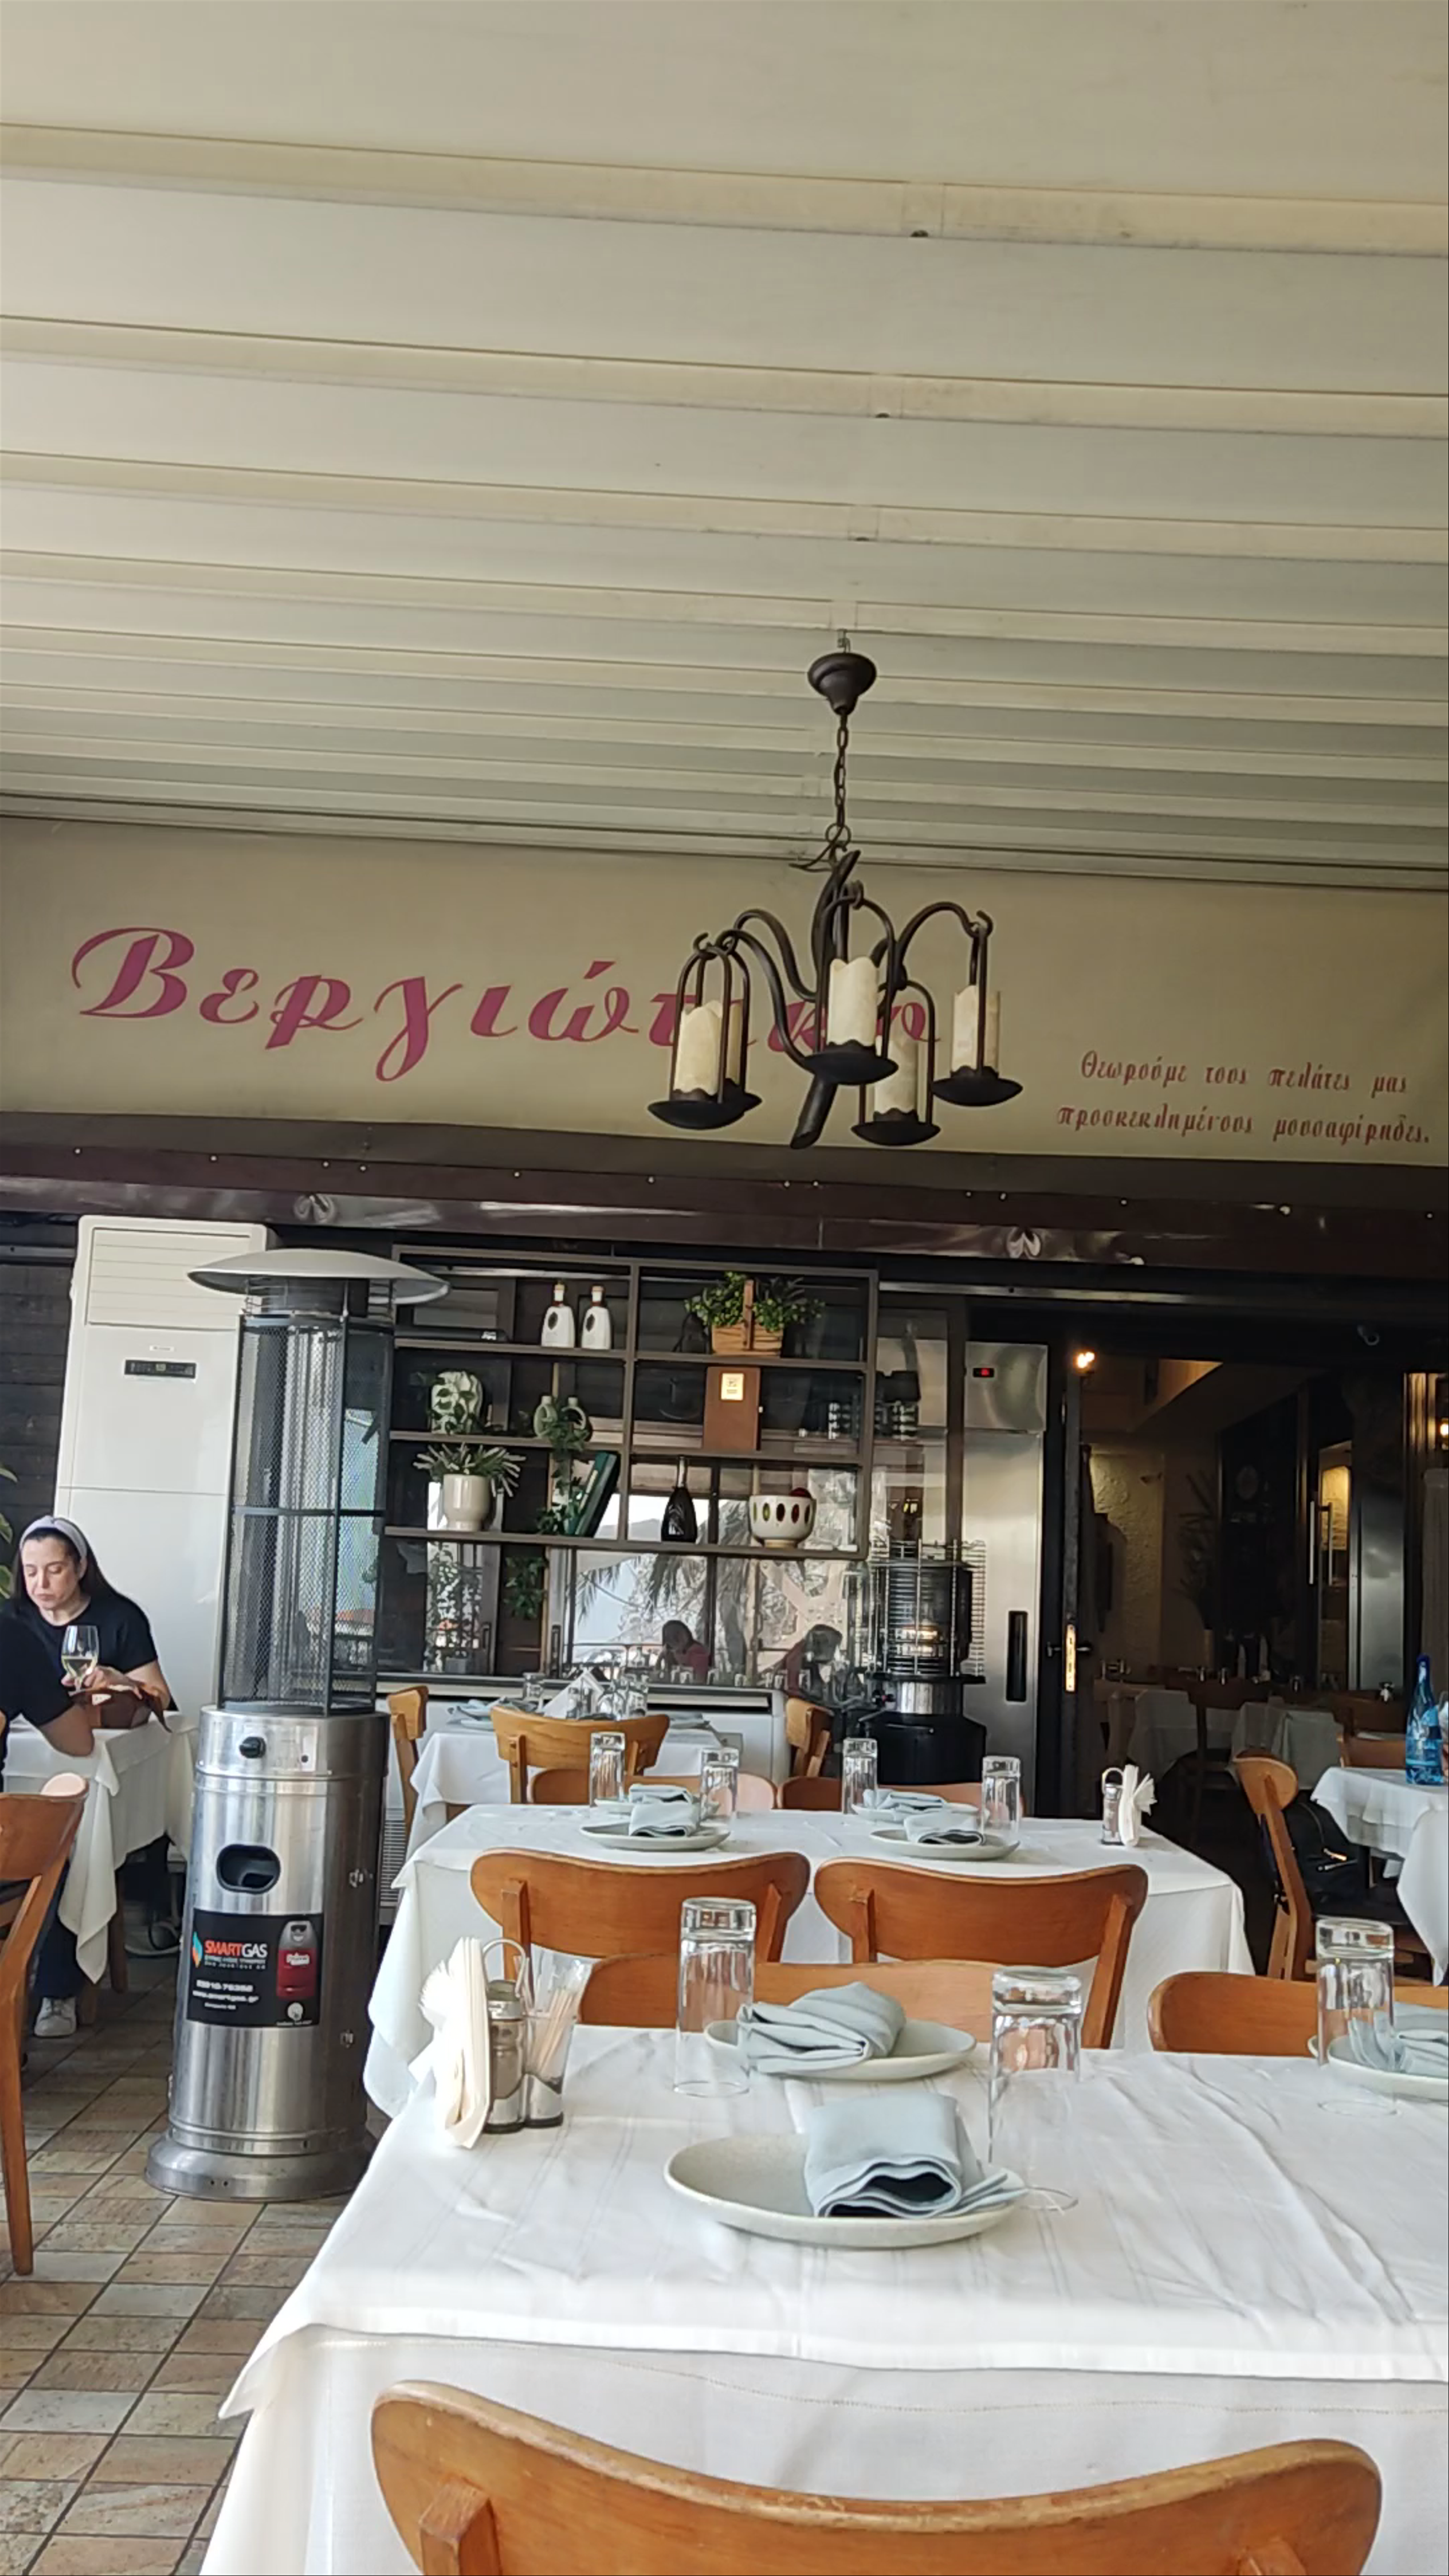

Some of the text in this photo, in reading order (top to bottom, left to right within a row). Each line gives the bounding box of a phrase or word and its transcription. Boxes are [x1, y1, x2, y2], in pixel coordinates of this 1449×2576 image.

[72, 926, 941, 1082] Βεργιώτκο
[1081, 1050, 1407, 1100] Θεωρούμε τους πελάτες μας
[1057, 1103, 1430, 1146] προσκεκλημένους μουσαφίρηδες.
[205, 1940, 268, 1958] SMARTGAS
